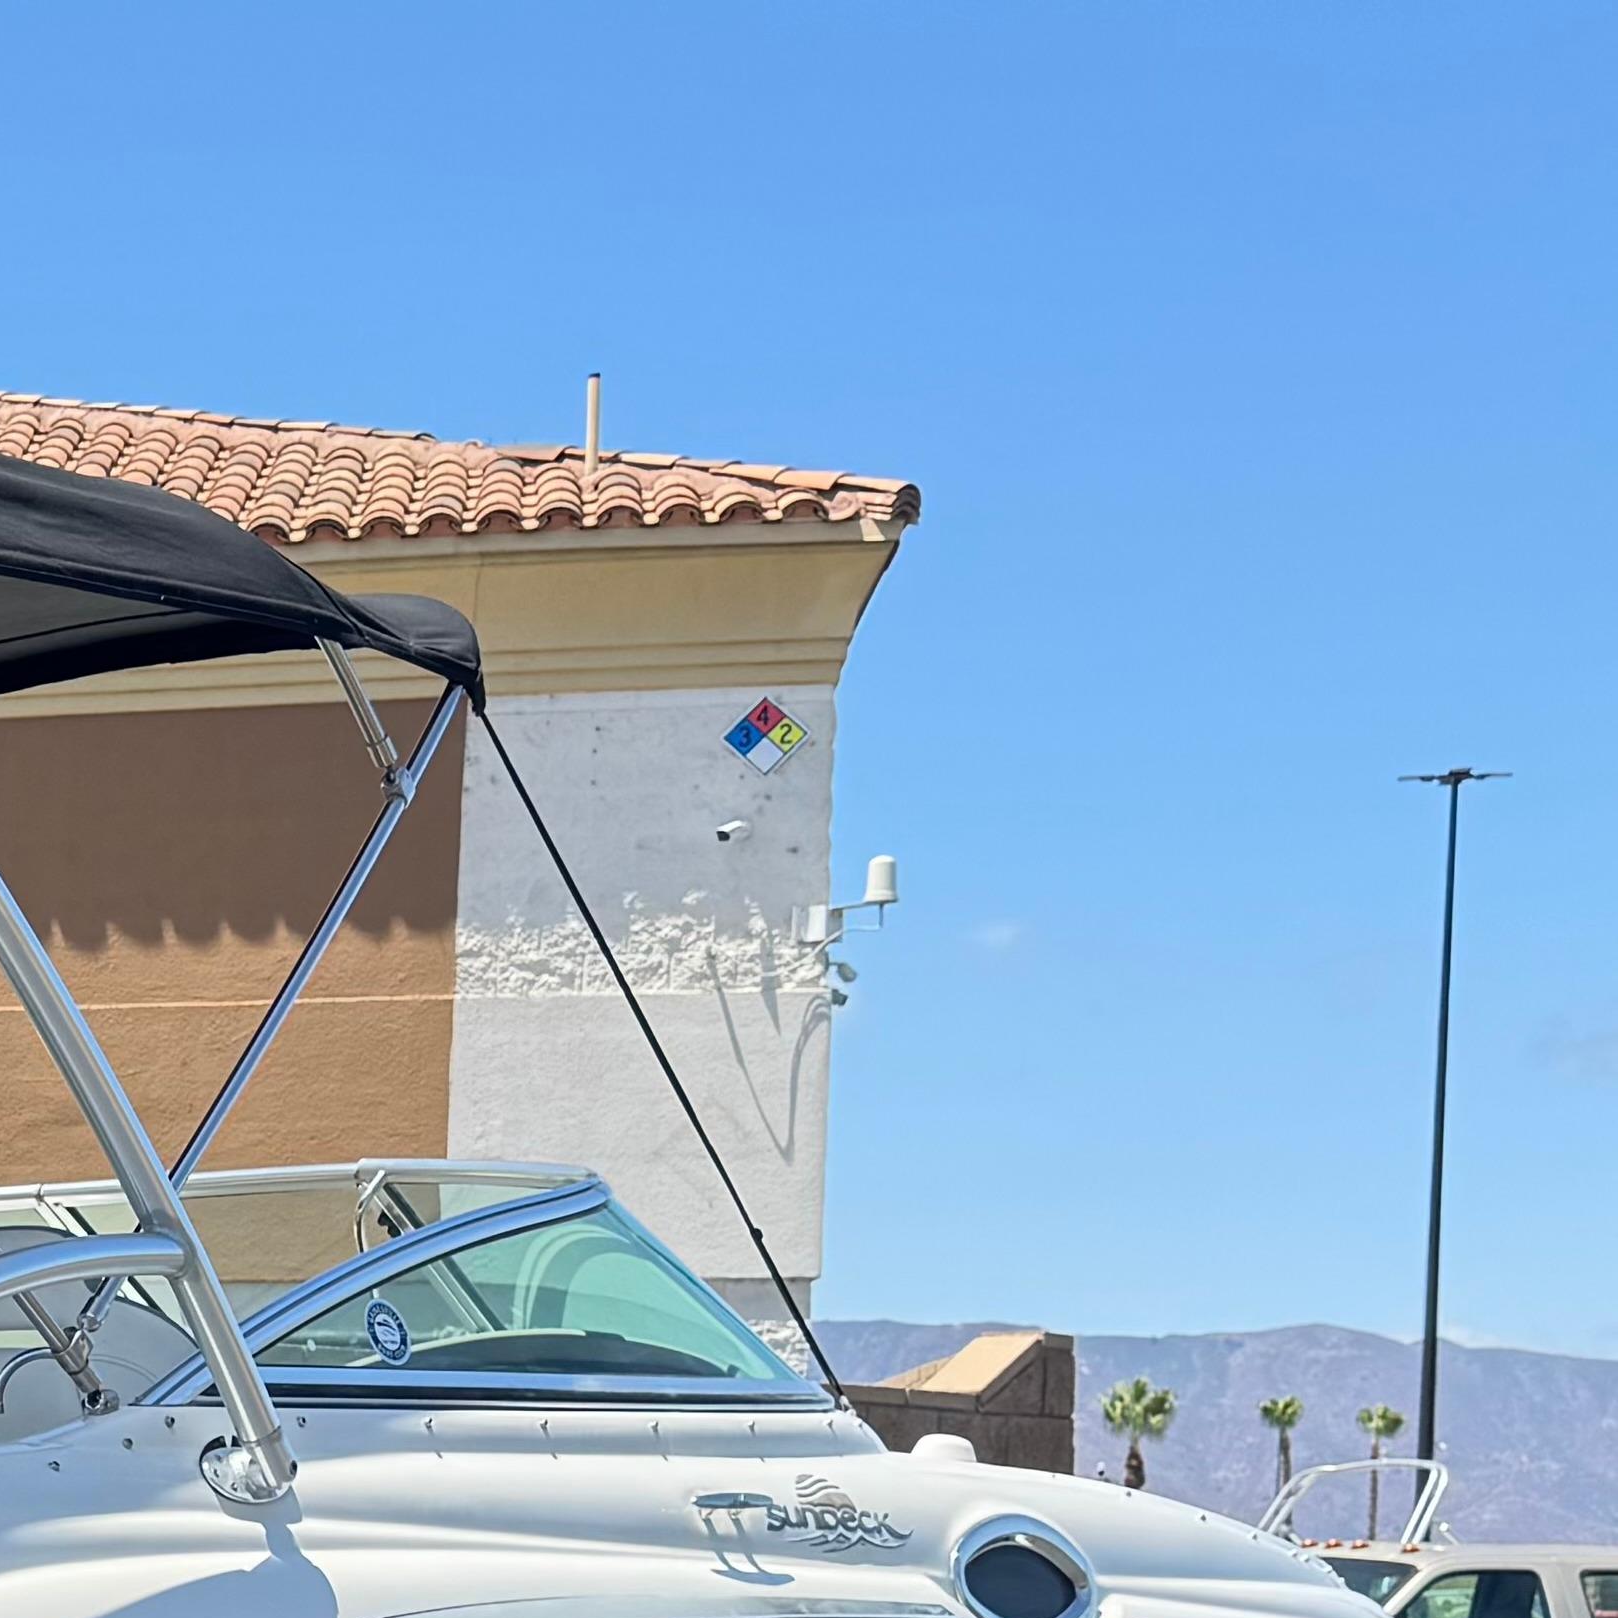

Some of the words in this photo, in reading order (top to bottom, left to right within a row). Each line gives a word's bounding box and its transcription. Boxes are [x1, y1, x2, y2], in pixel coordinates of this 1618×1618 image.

[756, 705, 769, 726] 4
[738, 727, 751, 748] 3
[779, 722, 793, 745] 2
